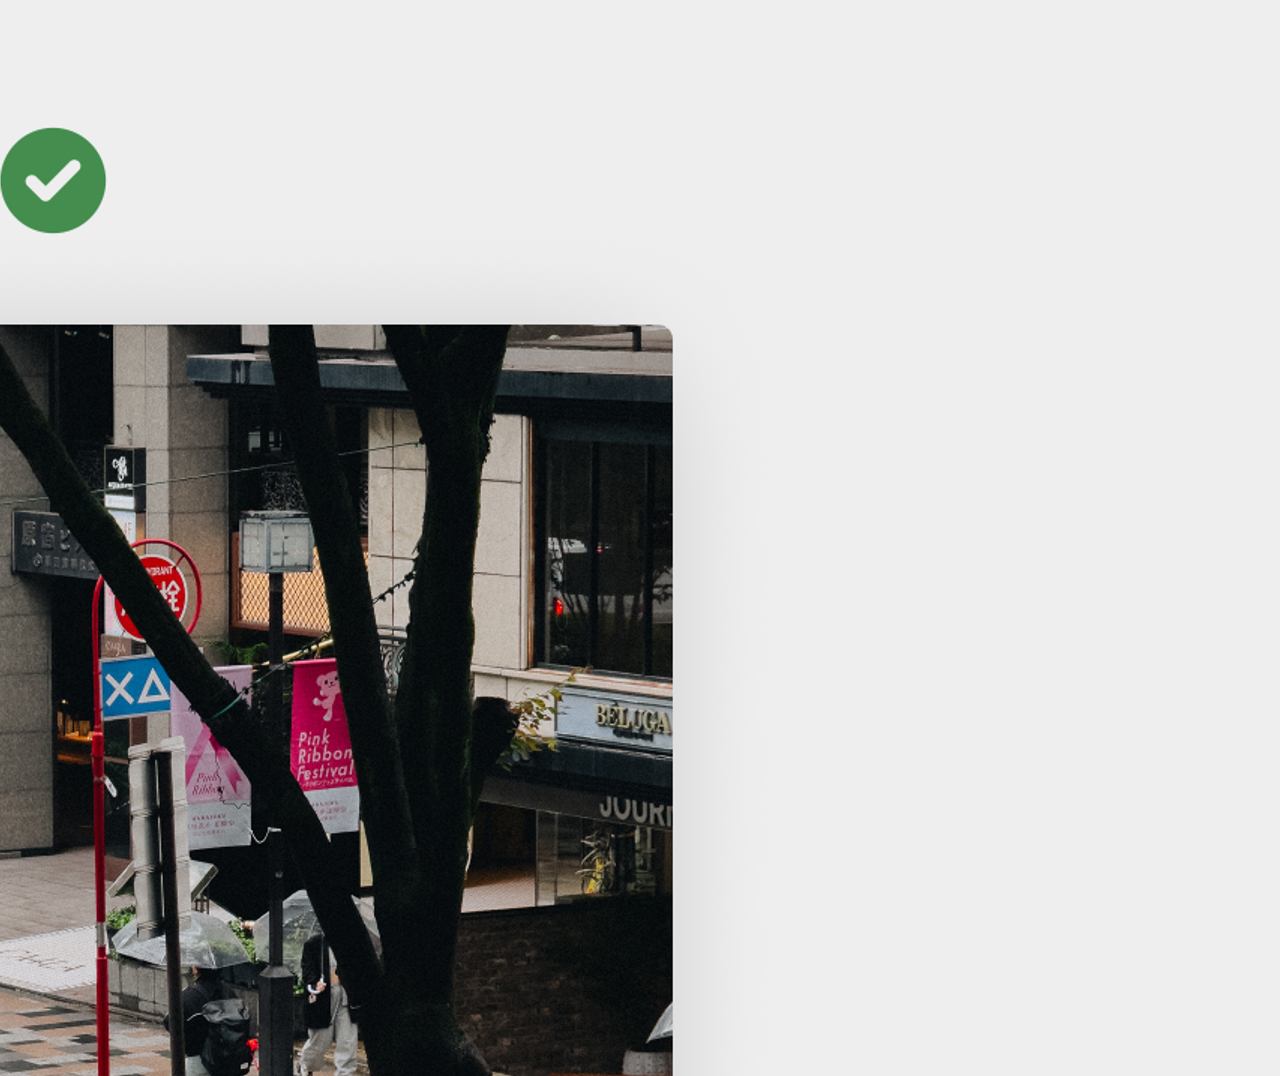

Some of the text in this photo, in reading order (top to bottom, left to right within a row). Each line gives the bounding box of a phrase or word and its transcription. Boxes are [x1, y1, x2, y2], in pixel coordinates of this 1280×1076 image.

[146, 565, 173, 577] YDRANT
[298, 728, 331, 747] Pink
[297, 747, 353, 765] Ribbon
[297, 759, 354, 781] Festival
